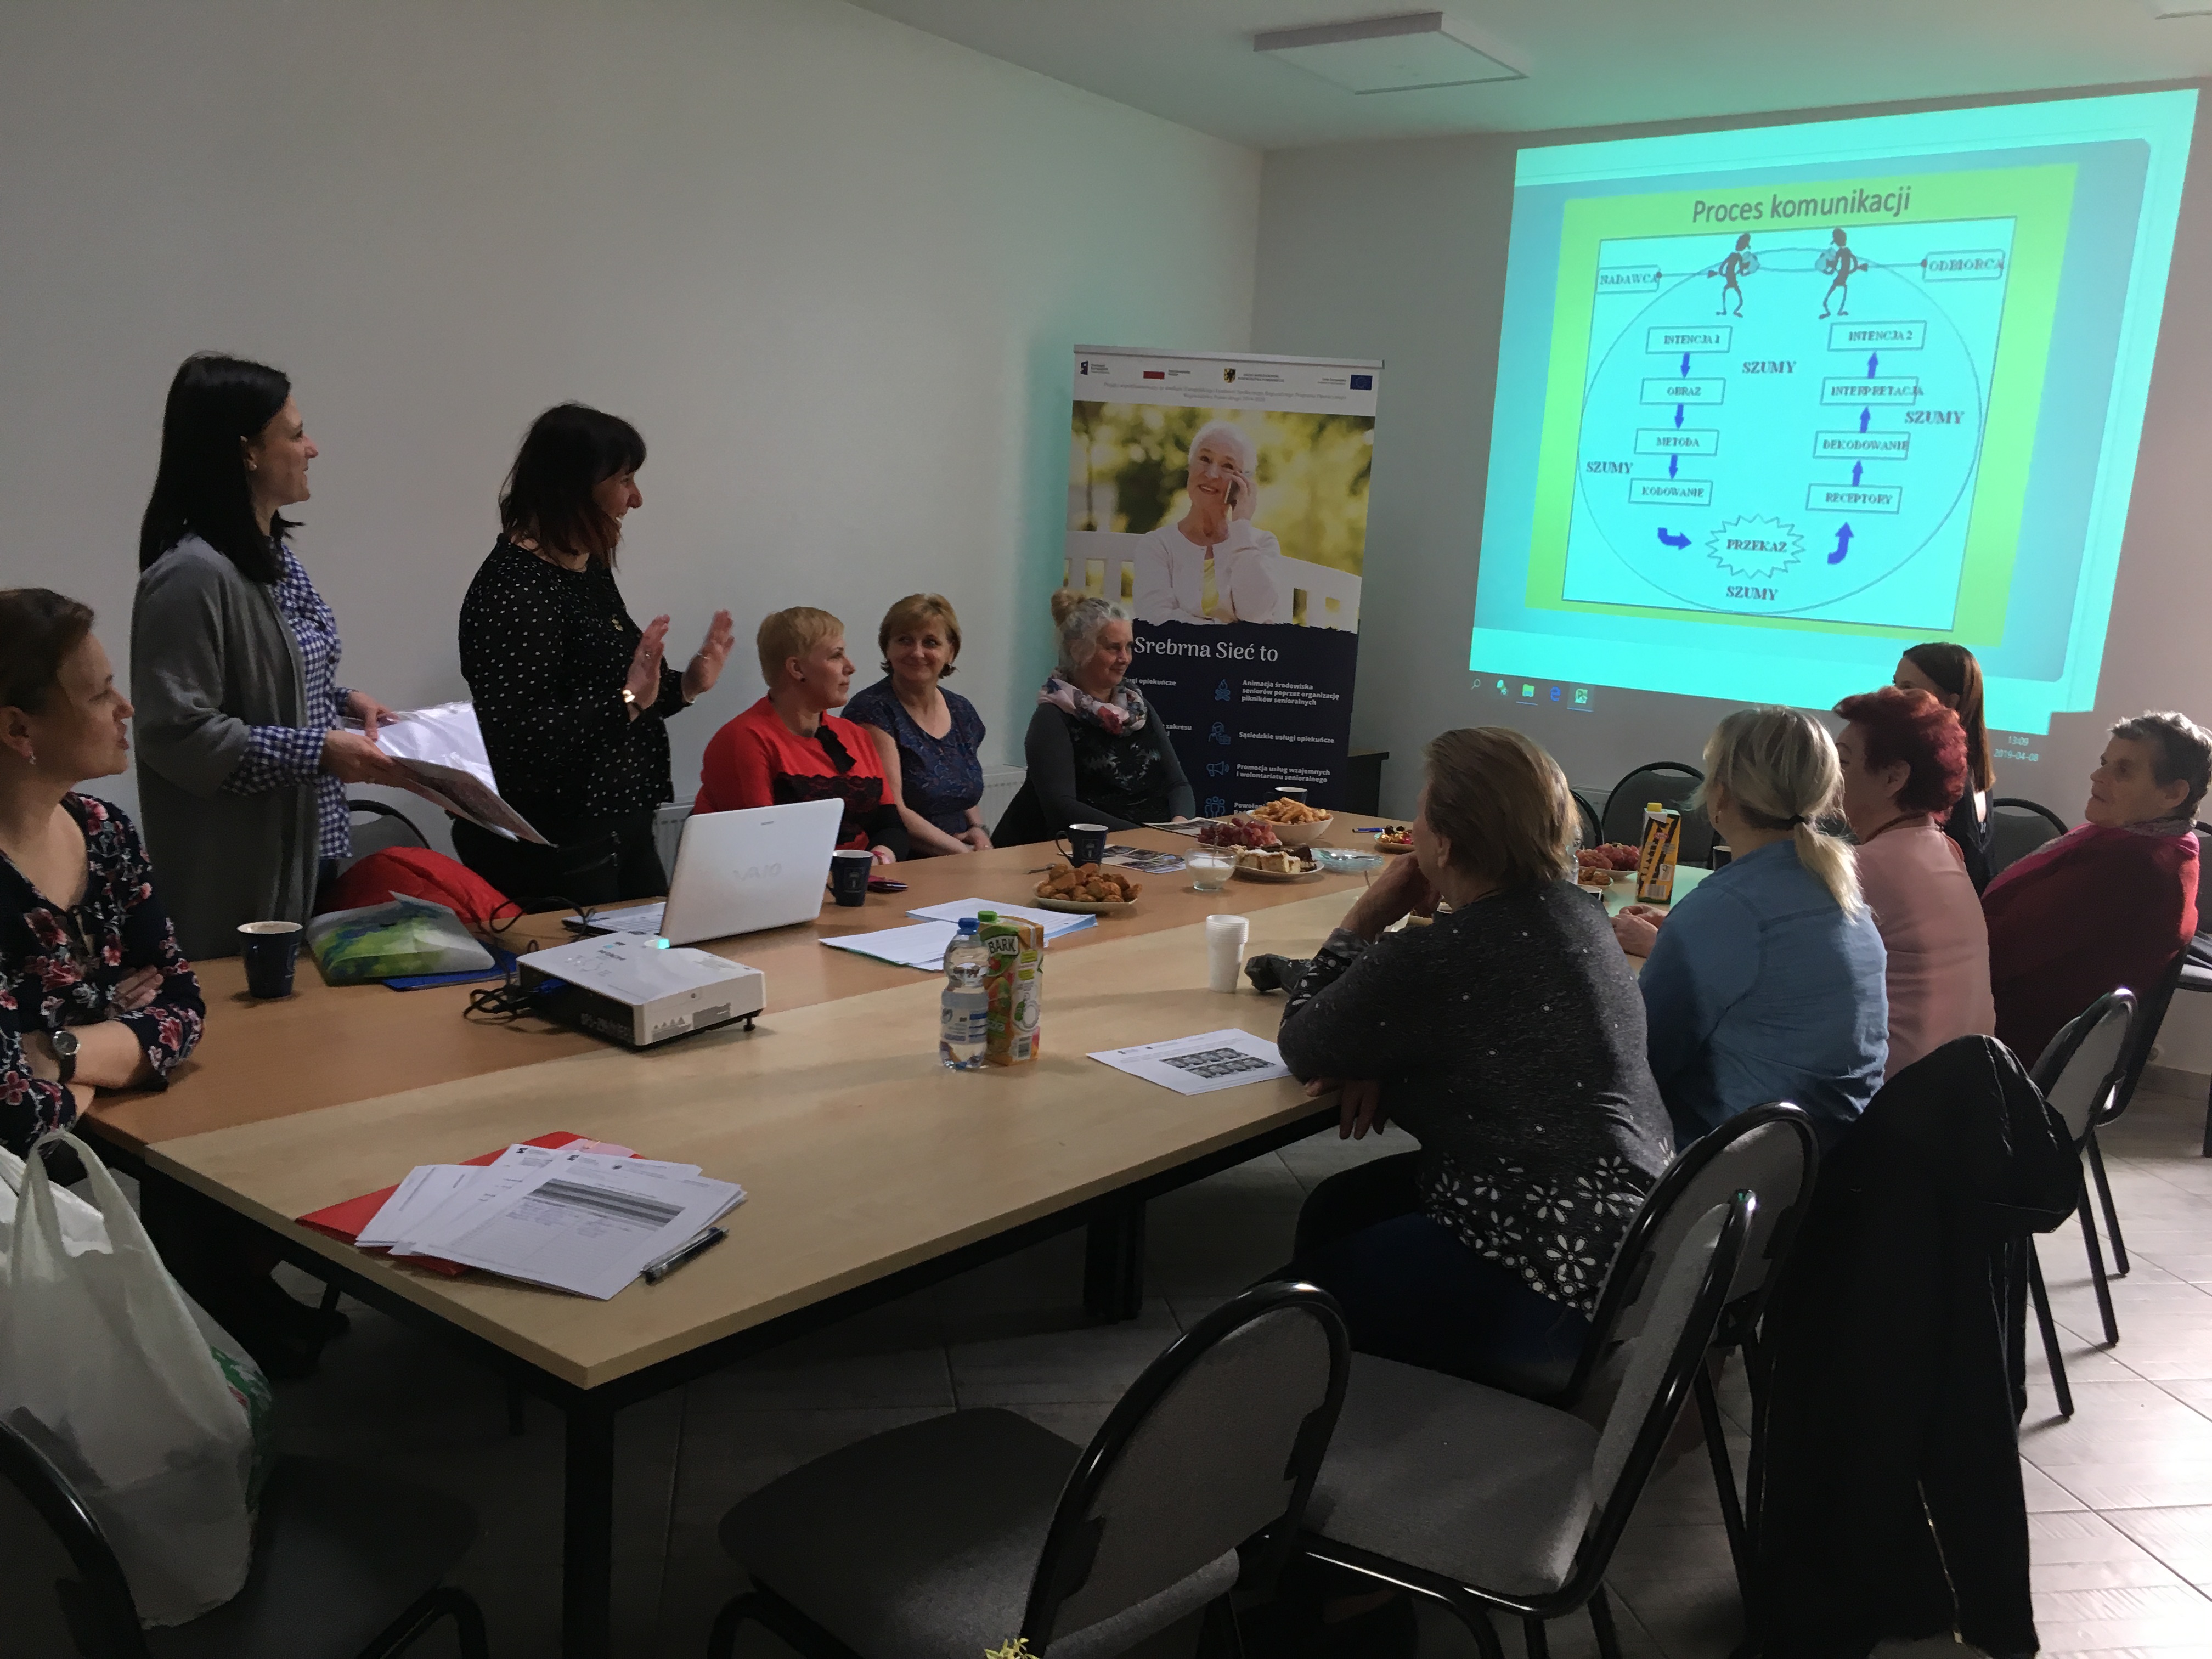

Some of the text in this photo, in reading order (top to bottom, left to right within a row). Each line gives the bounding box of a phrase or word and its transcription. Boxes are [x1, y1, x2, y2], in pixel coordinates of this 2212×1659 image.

[1692, 185, 1911, 223] Proces komunikacji
[1929, 258, 2004, 272] ODBIORCA
[1599, 273, 1658, 285] NADAWCA
[1664, 334, 1712, 345] INTENCJA
[1848, 330, 1913, 341] INTENCJA 2
[1742, 360, 1797, 374] SZUMY
[1667, 386, 1702, 396] OBRAZ
[1831, 385, 1924, 396] INTERPRETACJA
[1904, 410, 1965, 424] SZUMY
[1656, 436, 1700, 448] METODA
[1822, 439, 1909, 452] DEKODOWANIE
[1585, 461, 1633, 475] SZUMY
[1642, 486, 1705, 498] KODOWANIE
[1825, 492, 1893, 504] RECEPTORY
[1726, 539, 1787, 553] PRZEKAZ
[1726, 585, 1779, 601] SZUMY
[1133, 636, 1279, 662] Srebrna Sieć to
[1242, 680, 1313, 690] Animacja środowiska
[1274, 697, 1317, 706] senioralnych
[1301, 692, 1340, 701] organizację
[1274, 734, 1296, 742] usługi
[2008, 736, 2029, 746] 13:09
[1237, 764, 1330, 776] Promocja usług wzajemnych
[1284, 775, 1328, 784] senioralnego
[732, 862, 782, 882] VAIO
